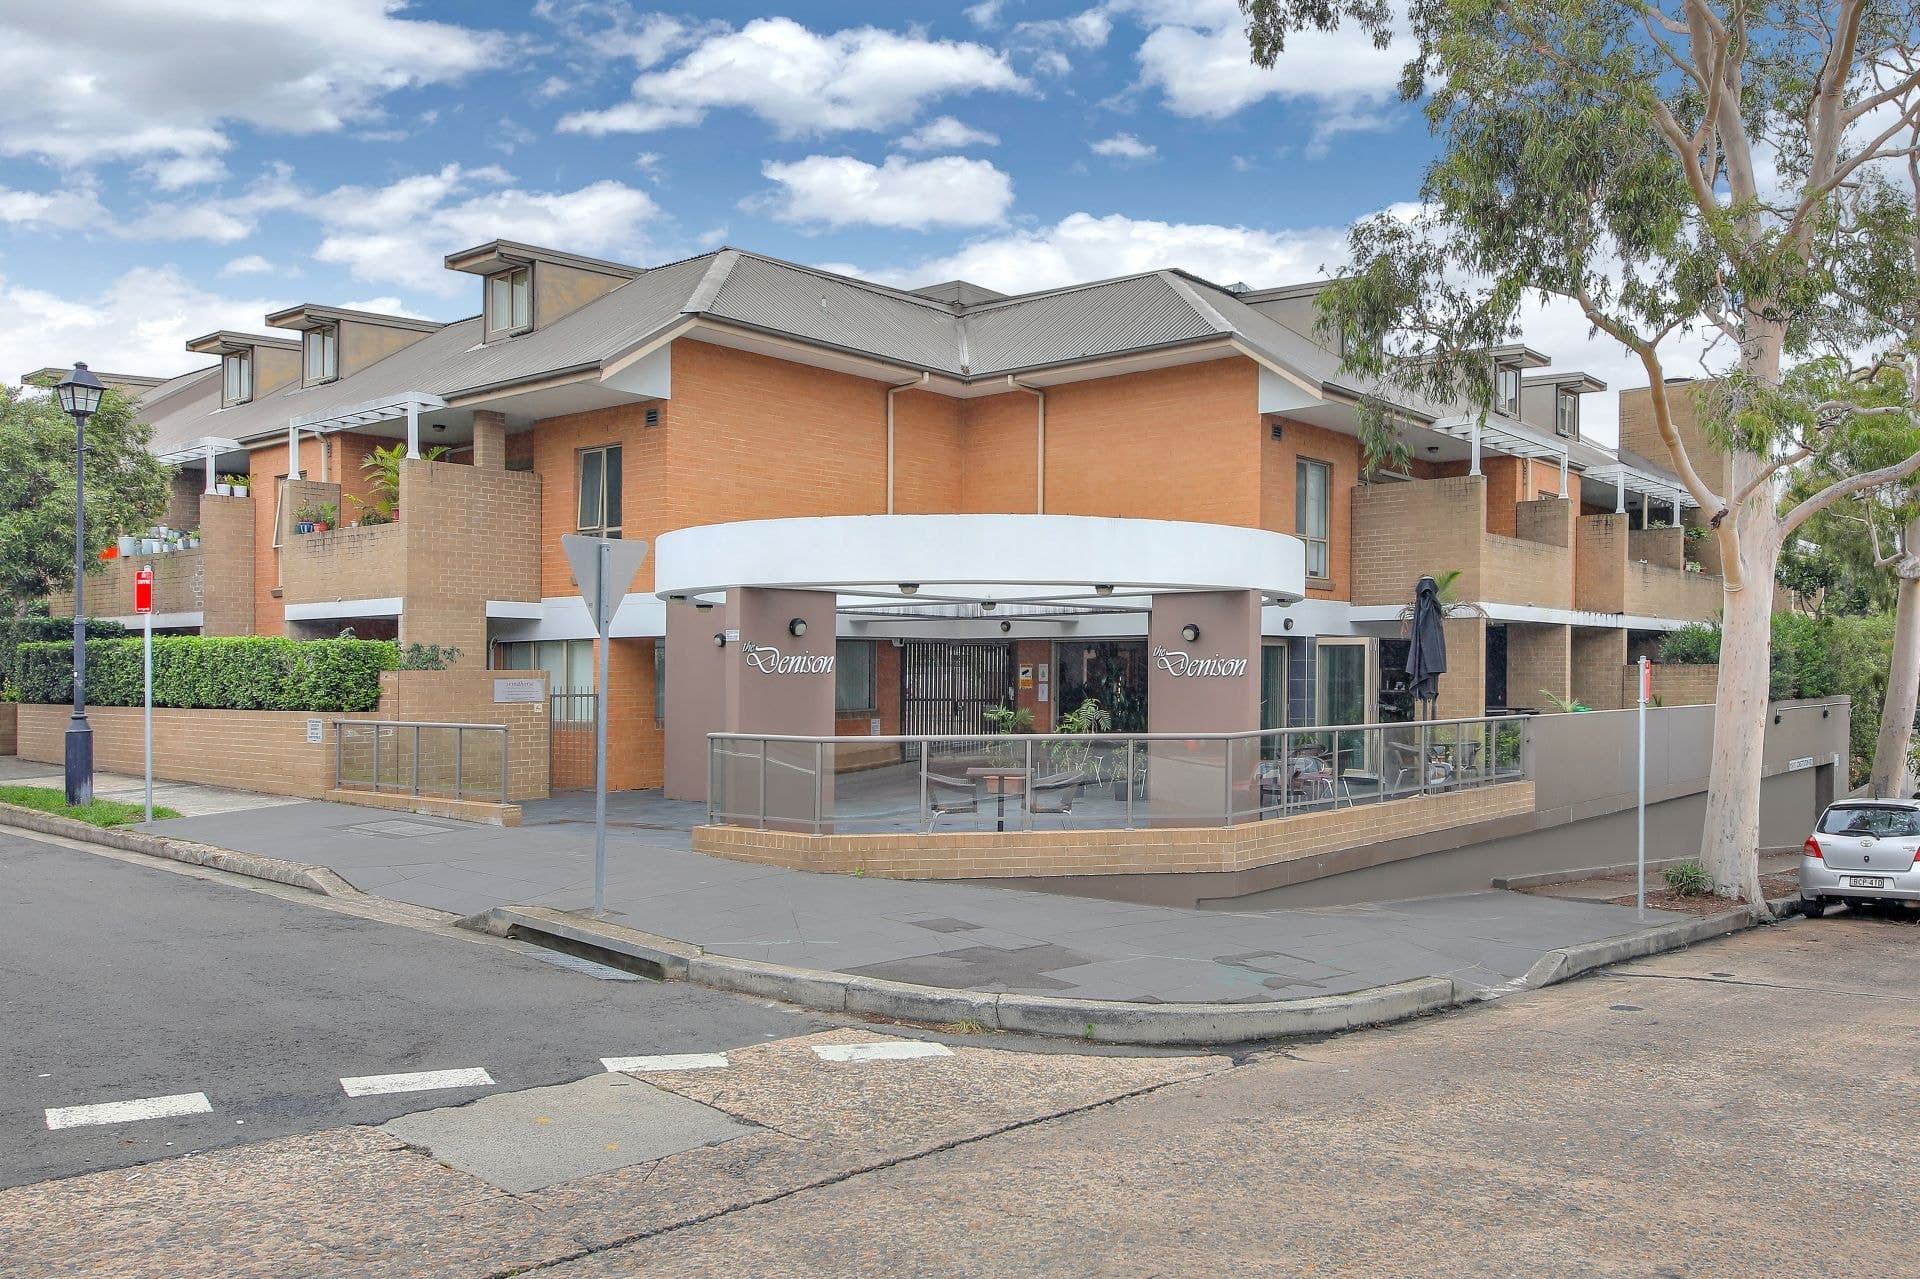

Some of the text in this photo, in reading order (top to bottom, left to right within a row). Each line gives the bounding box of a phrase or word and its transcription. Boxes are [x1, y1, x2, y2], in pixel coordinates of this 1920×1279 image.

[742, 641, 834, 674] the Denison
[1153, 645, 1247, 676] the Denison
